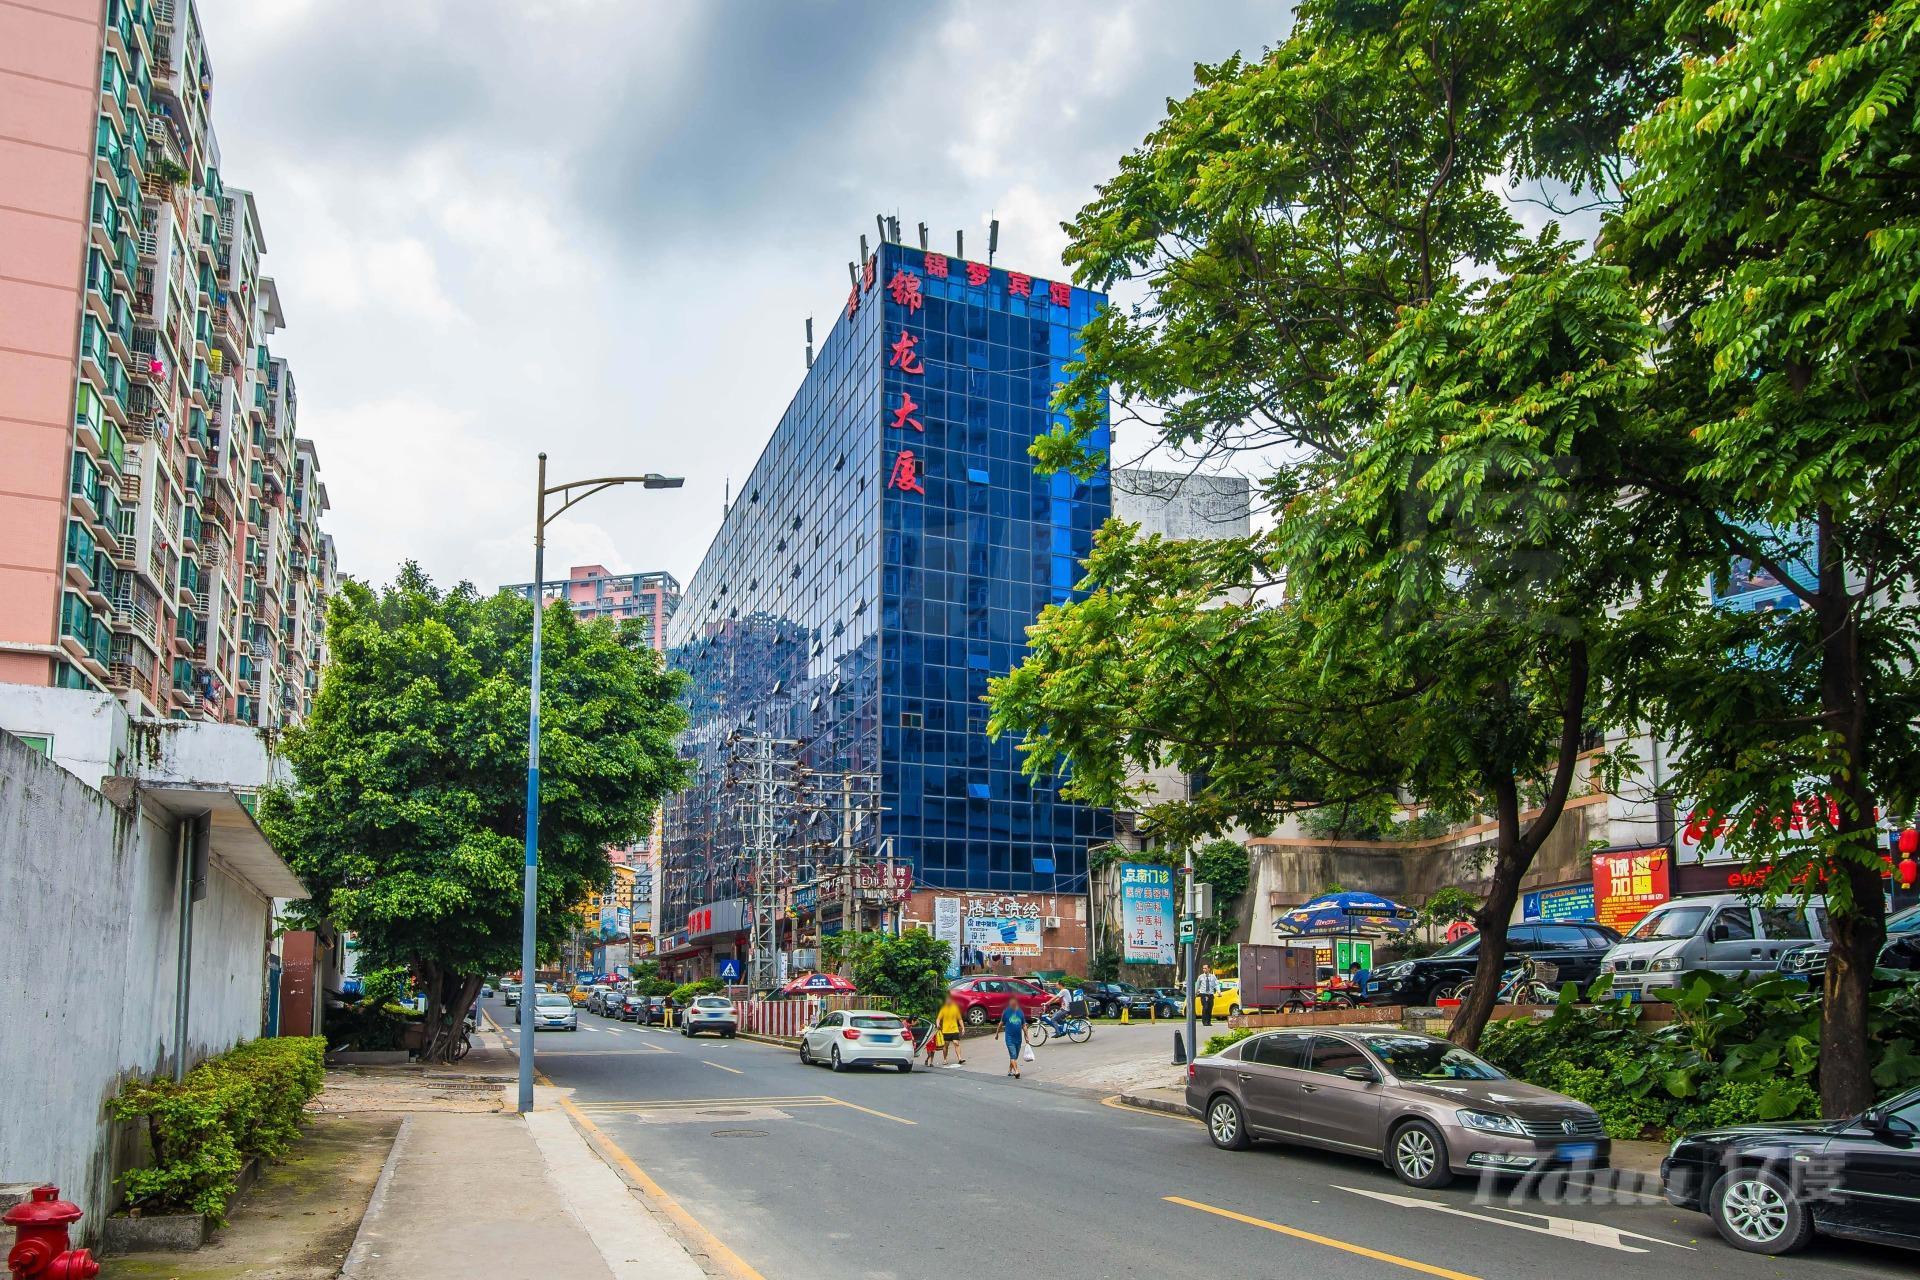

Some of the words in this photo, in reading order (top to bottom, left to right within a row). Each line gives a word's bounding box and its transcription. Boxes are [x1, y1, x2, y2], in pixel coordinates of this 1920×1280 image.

[924, 251, 1071, 308] 锦梦宾馆
[887, 269, 925, 496] 锦龙大厦
[1125, 868, 1169, 884] 京南门诊
[967, 899, 1040, 919] 腾峰喷绘
[1136, 901, 1162, 912] 妇产科
[1136, 915, 1162, 926] 中医科
